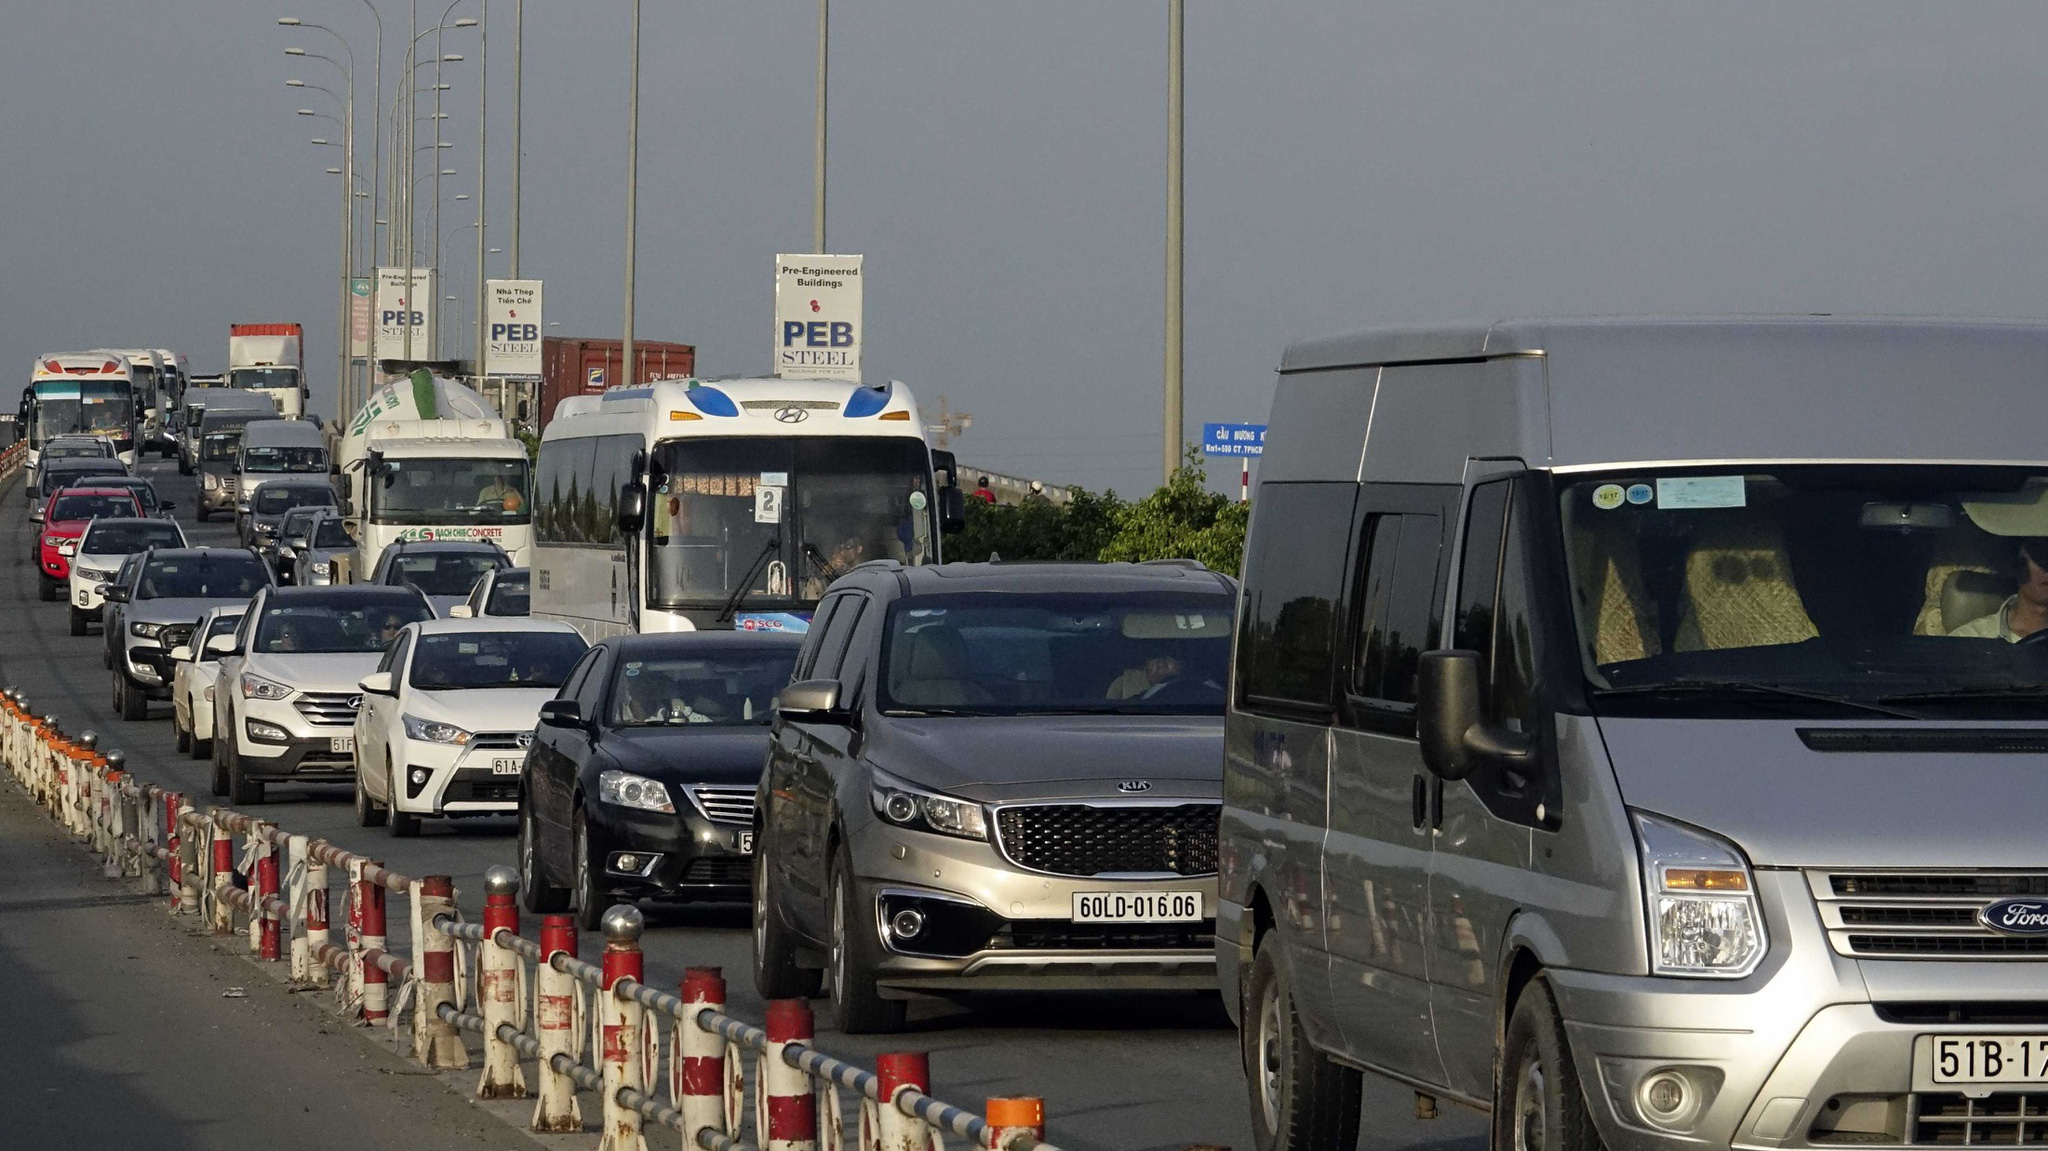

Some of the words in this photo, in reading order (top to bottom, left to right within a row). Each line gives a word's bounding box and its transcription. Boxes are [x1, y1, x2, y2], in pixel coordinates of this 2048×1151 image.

[782, 266, 858, 277] Pre-Engineered
[797, 279, 843, 289] Buildings
[491, 323, 539, 341] PEB
[783, 321, 855, 349] PEB
[491, 343, 539, 353] STEEL
[782, 350, 854, 366] STEEL
[763, 490, 774, 511] 2
[758, 620, 783, 628] SCG
[1122, 781, 1147, 790] KIA
[1080, 896, 1195, 918] 60LD-016.06
